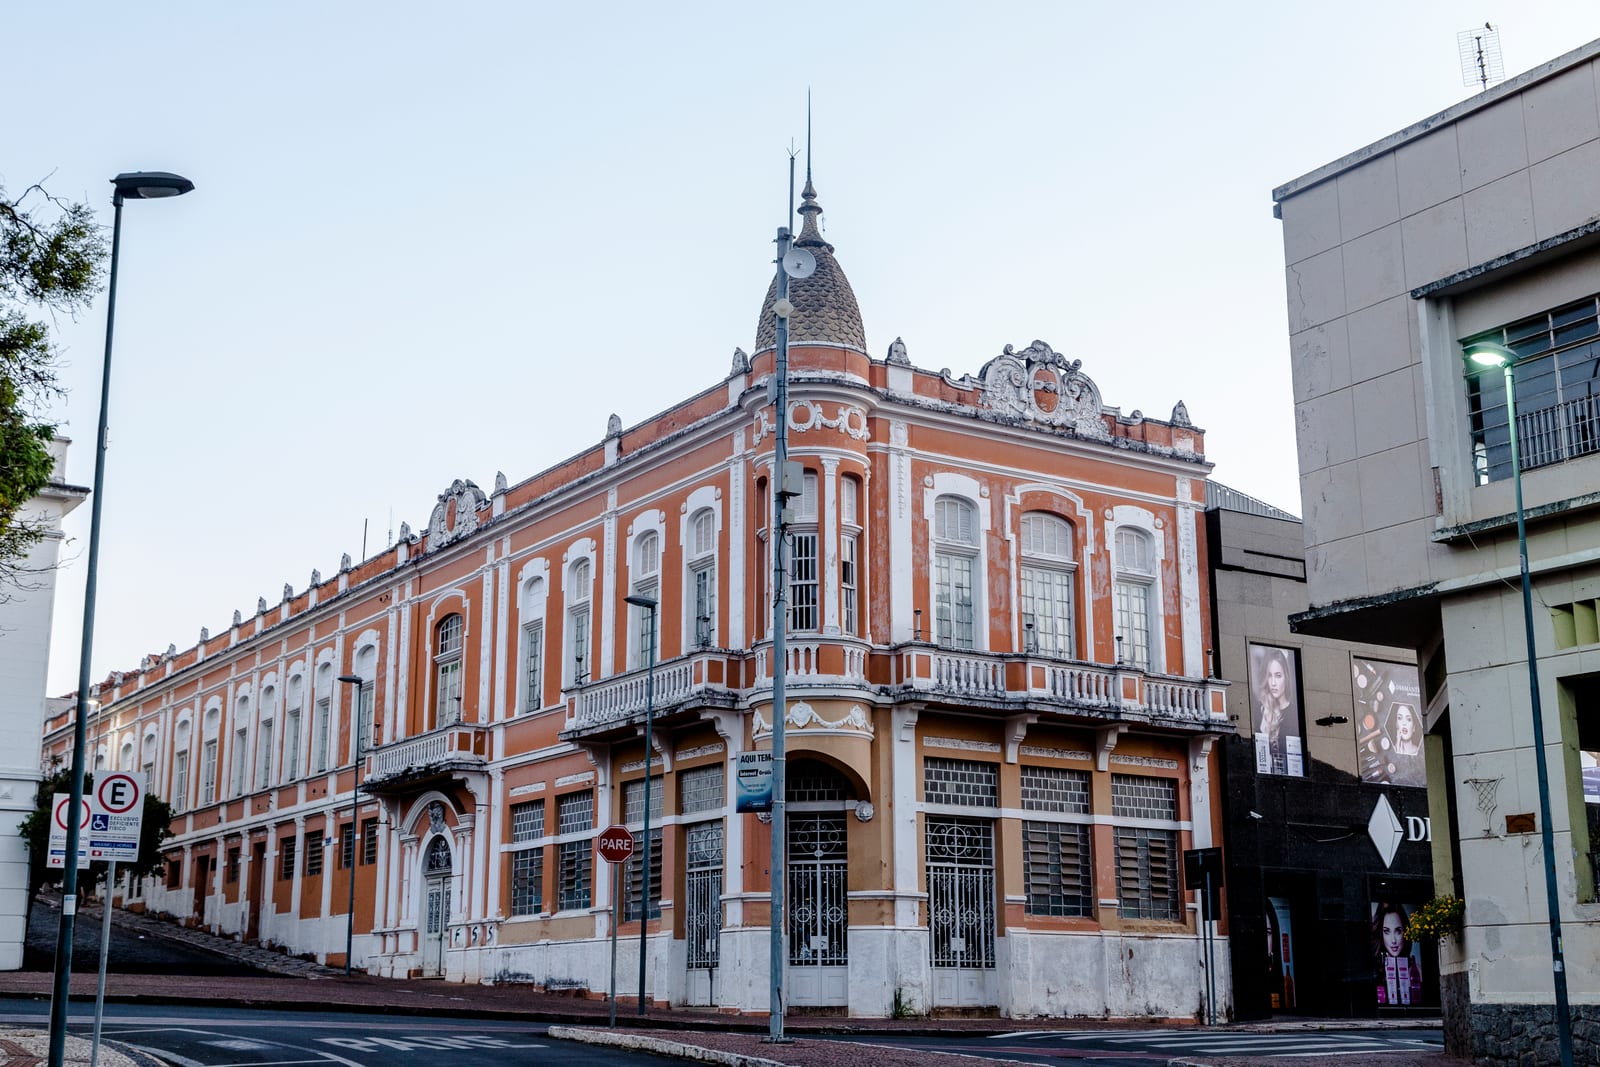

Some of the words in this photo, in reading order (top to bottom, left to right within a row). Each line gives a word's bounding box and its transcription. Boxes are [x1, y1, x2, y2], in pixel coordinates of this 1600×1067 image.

[741, 755, 756, 763] AQUI
[757, 754, 771, 762] TEM
[111, 783, 126, 805] E
[600, 838, 631, 851] PARE
